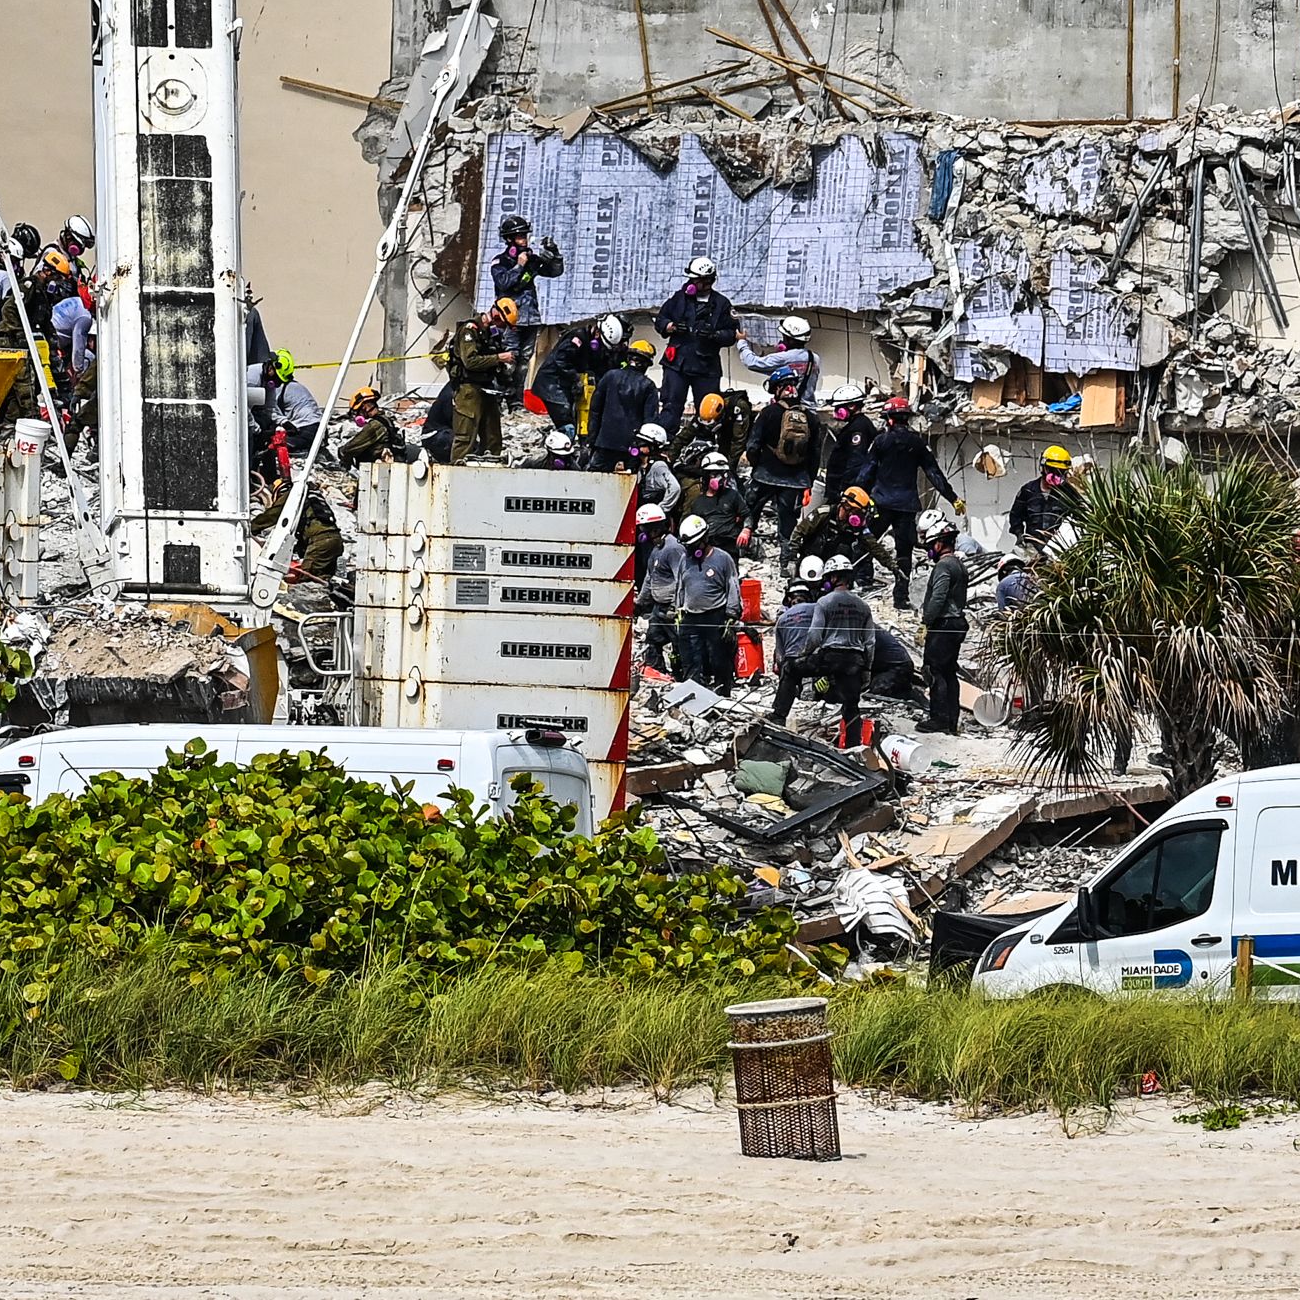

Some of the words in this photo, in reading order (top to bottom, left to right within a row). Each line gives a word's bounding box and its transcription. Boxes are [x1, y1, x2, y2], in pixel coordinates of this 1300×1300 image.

[592, 196, 614, 294] PROFLEX
[506, 498, 593, 512] LIEBHERR
[503, 553, 590, 567] LIEBHERR
[501, 589, 589, 603] LIEBHERR
[502, 644, 589, 658] LIEBHERR
[1122, 978, 1153, 989] COUNTY
